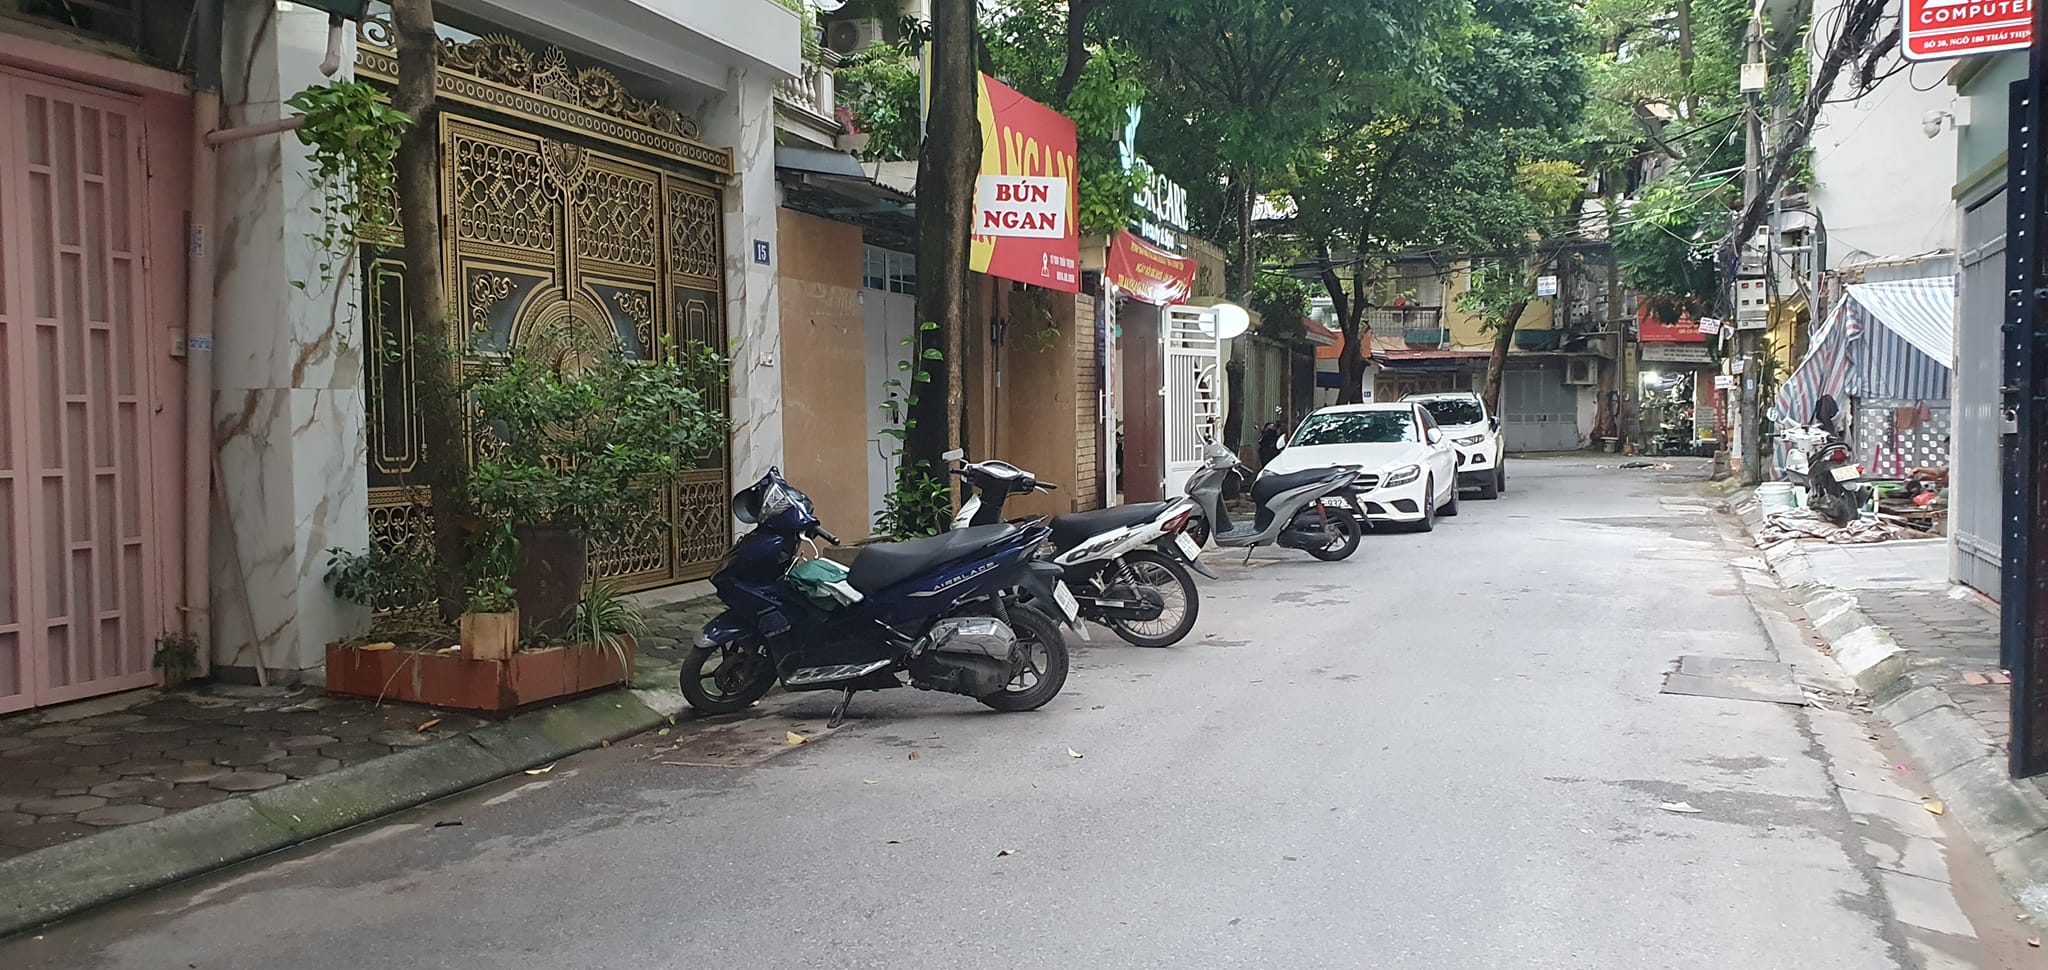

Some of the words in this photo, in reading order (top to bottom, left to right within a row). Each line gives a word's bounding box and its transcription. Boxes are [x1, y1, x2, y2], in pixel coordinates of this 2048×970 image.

[996, 180, 1049, 204] BÚN
[983, 211, 1057, 231] NGAN
[757, 243, 767, 260] 15
